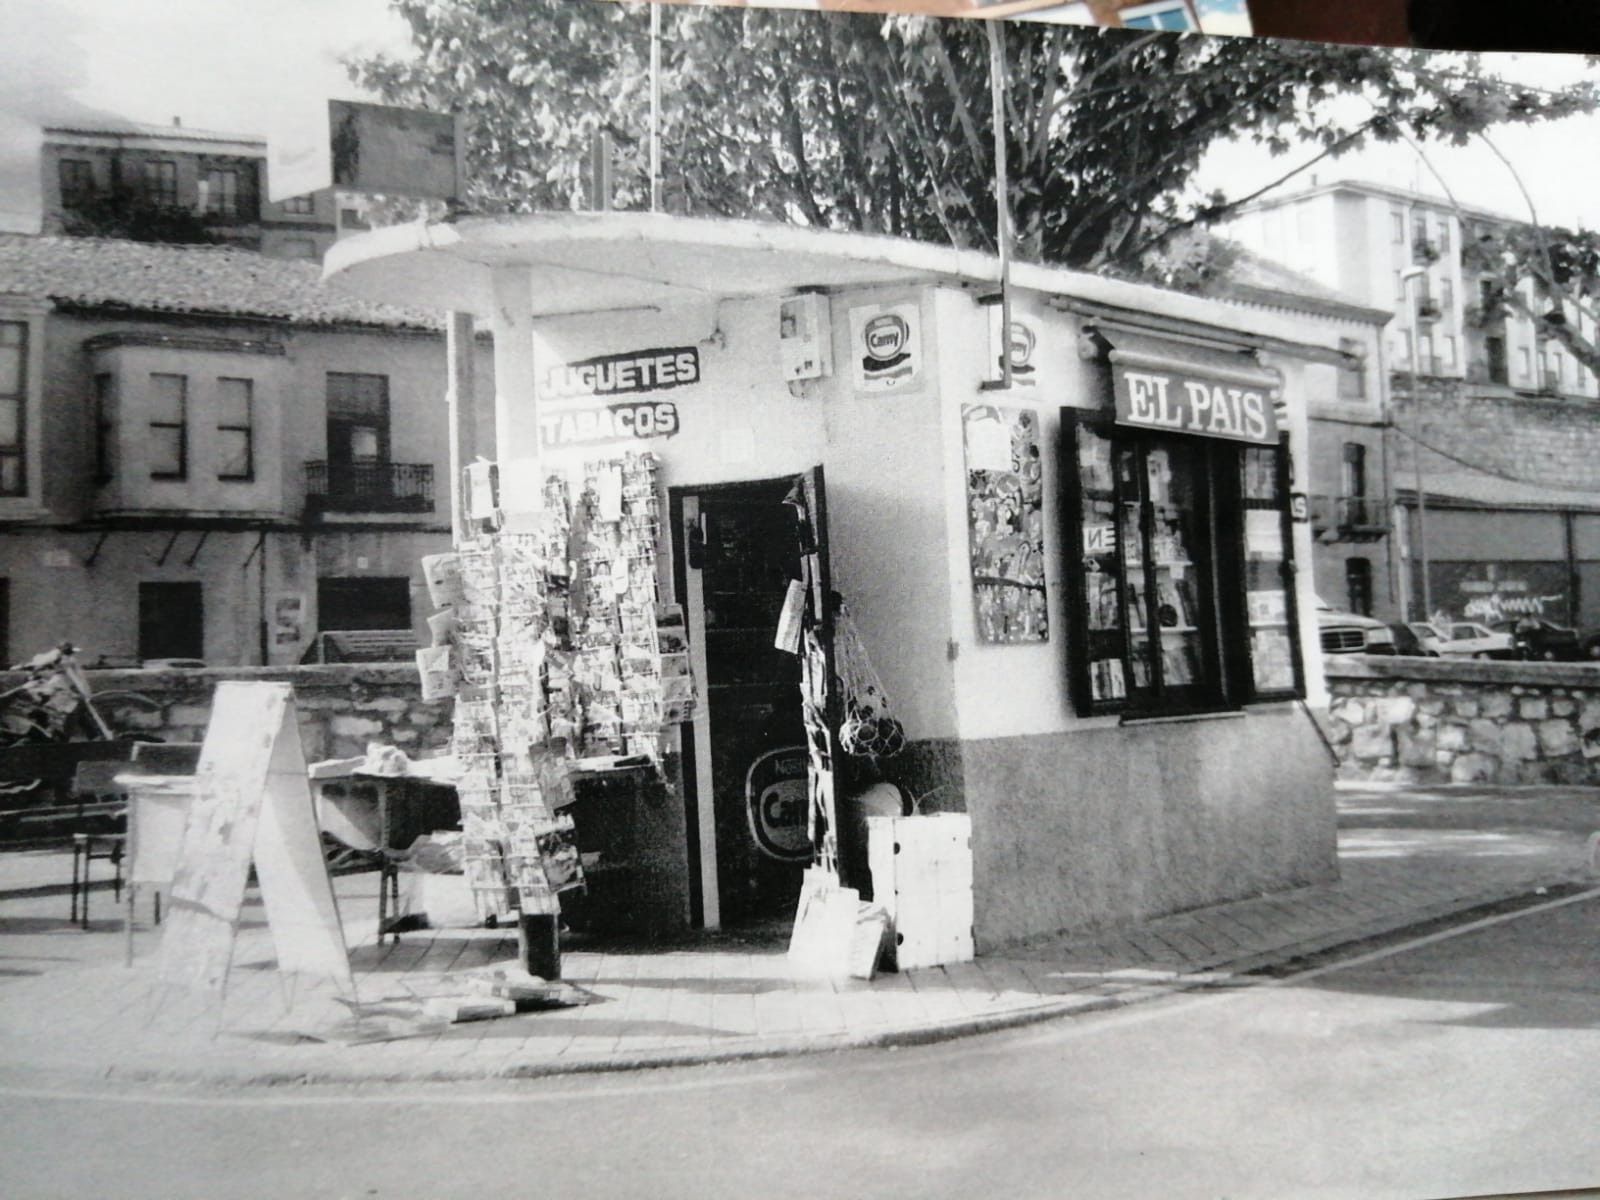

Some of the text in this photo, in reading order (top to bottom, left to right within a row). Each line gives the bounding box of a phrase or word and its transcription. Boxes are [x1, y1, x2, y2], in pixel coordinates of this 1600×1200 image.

[870, 331, 899, 348] Camy
[540, 352, 696, 397] JUGUETES
[540, 403, 675, 446] TABACOS
[1123, 372, 1267, 439] EL PAIS
